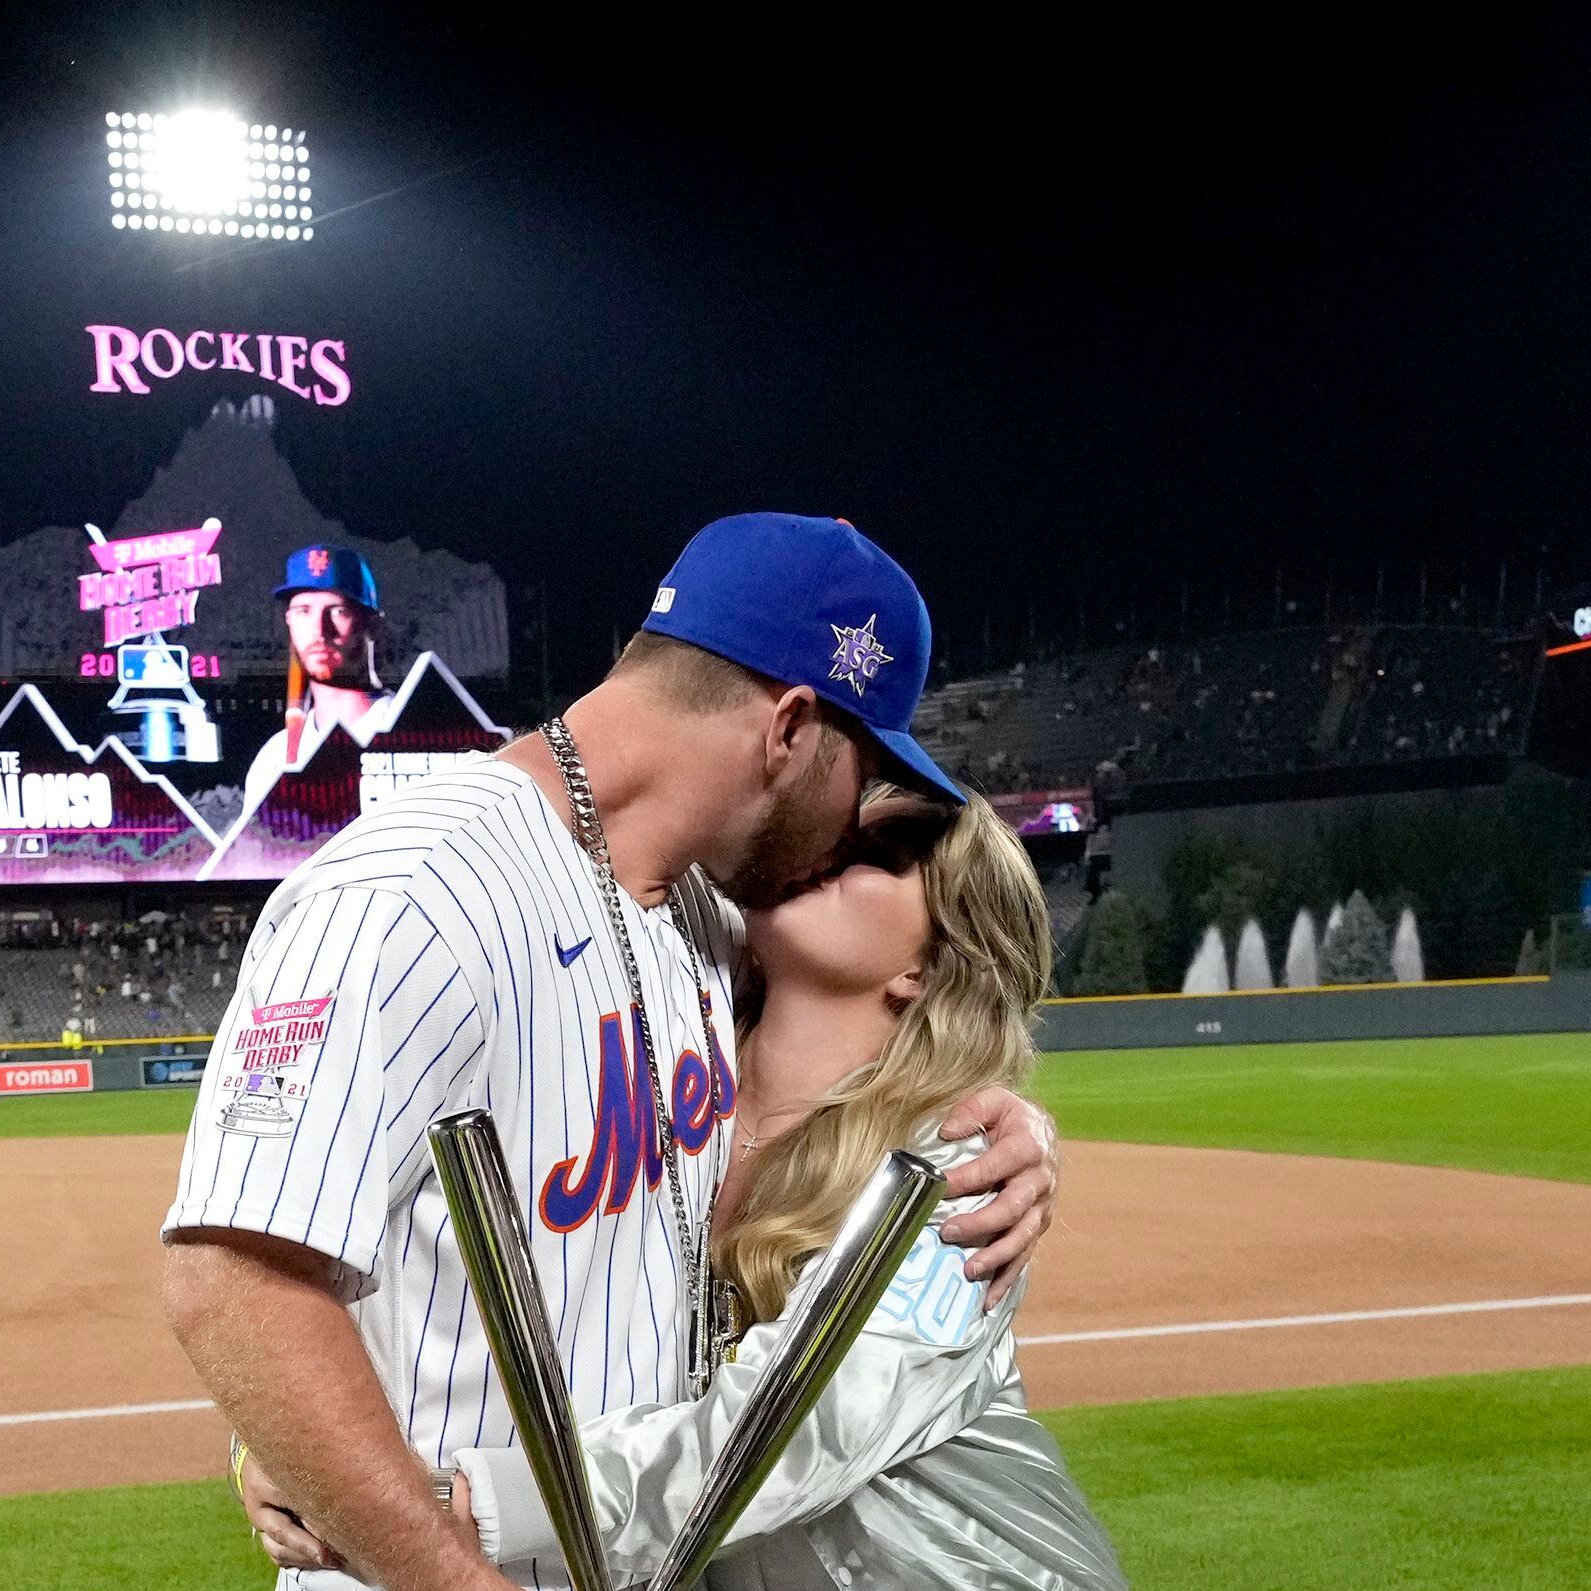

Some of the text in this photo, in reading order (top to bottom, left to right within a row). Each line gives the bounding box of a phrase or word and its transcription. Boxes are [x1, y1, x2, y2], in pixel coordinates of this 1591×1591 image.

[84, 324, 351, 407] ROCKIES
[77, 553, 222, 611] HOME RUN
[104, 590, 199, 647] DERBY
[80, 654, 221, 678] 20 21
[831, 638, 880, 680] ASG
[273, 1002, 316, 1019] Mobile
[235, 1020, 325, 1050] HOME RUN
[242, 1044, 303, 1072] DERBY
[6, 1068, 78, 1087] roman
[538, 990, 737, 1234] Mes
